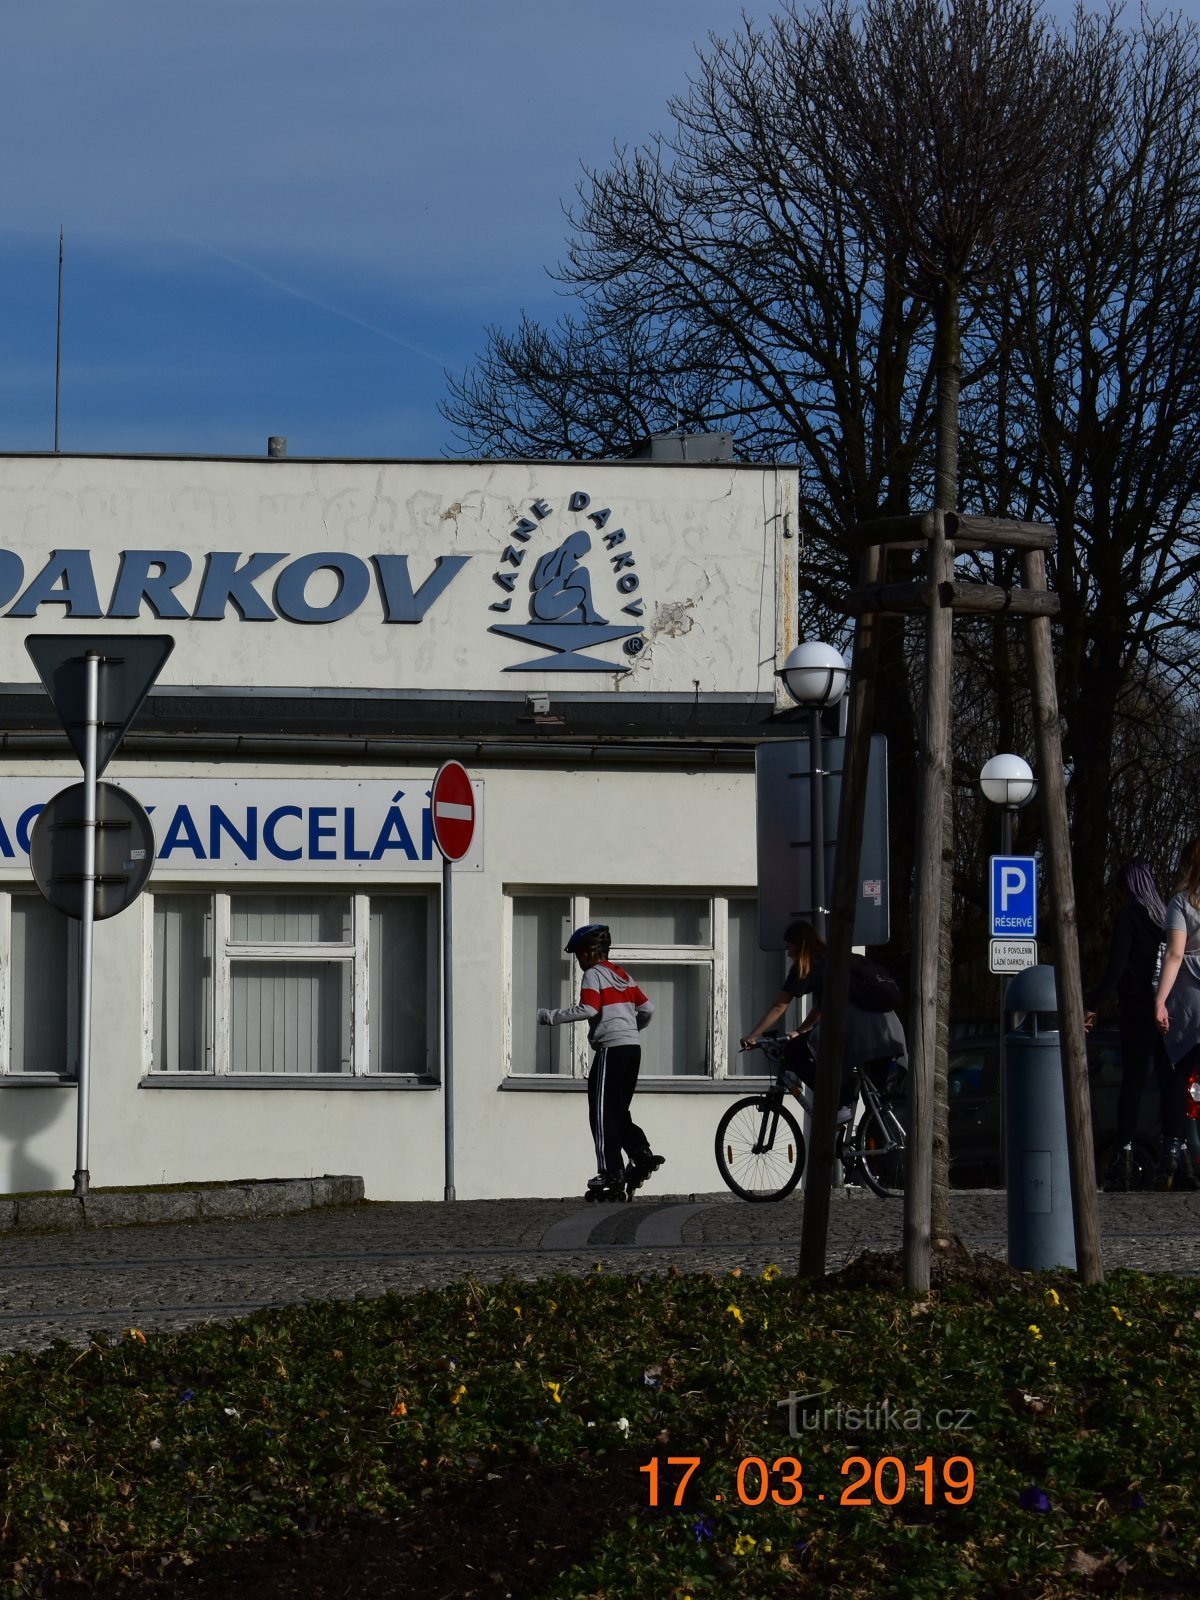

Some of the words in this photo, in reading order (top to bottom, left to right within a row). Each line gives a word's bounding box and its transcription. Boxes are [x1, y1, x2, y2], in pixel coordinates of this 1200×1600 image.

[568, 491, 644, 617] DARKOV
[1001, 866, 1026, 912] P
[995, 916, 1033, 928] RÉSERVÉ
